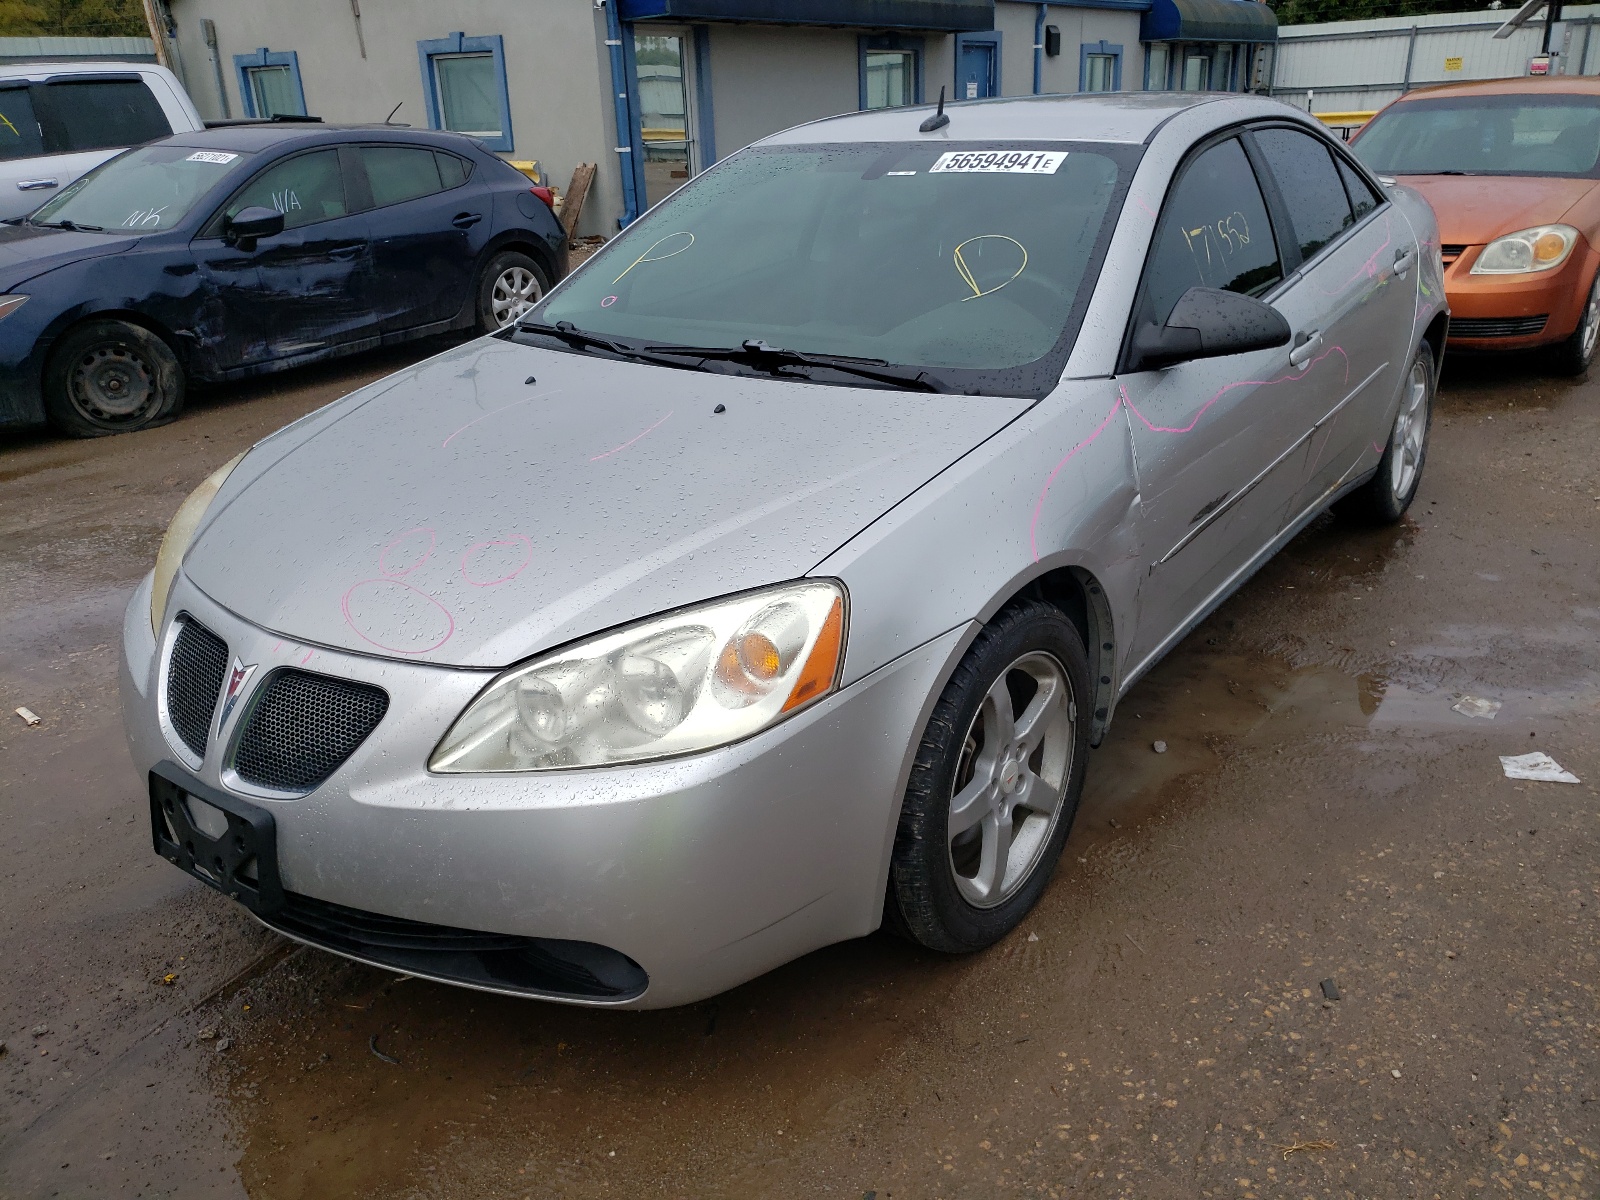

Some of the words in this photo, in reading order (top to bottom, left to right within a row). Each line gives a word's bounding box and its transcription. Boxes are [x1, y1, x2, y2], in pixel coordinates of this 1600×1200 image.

[945, 153, 1046, 170] 56594941
[1041, 158, 1054, 169] E
[271, 188, 302, 214] N/A
